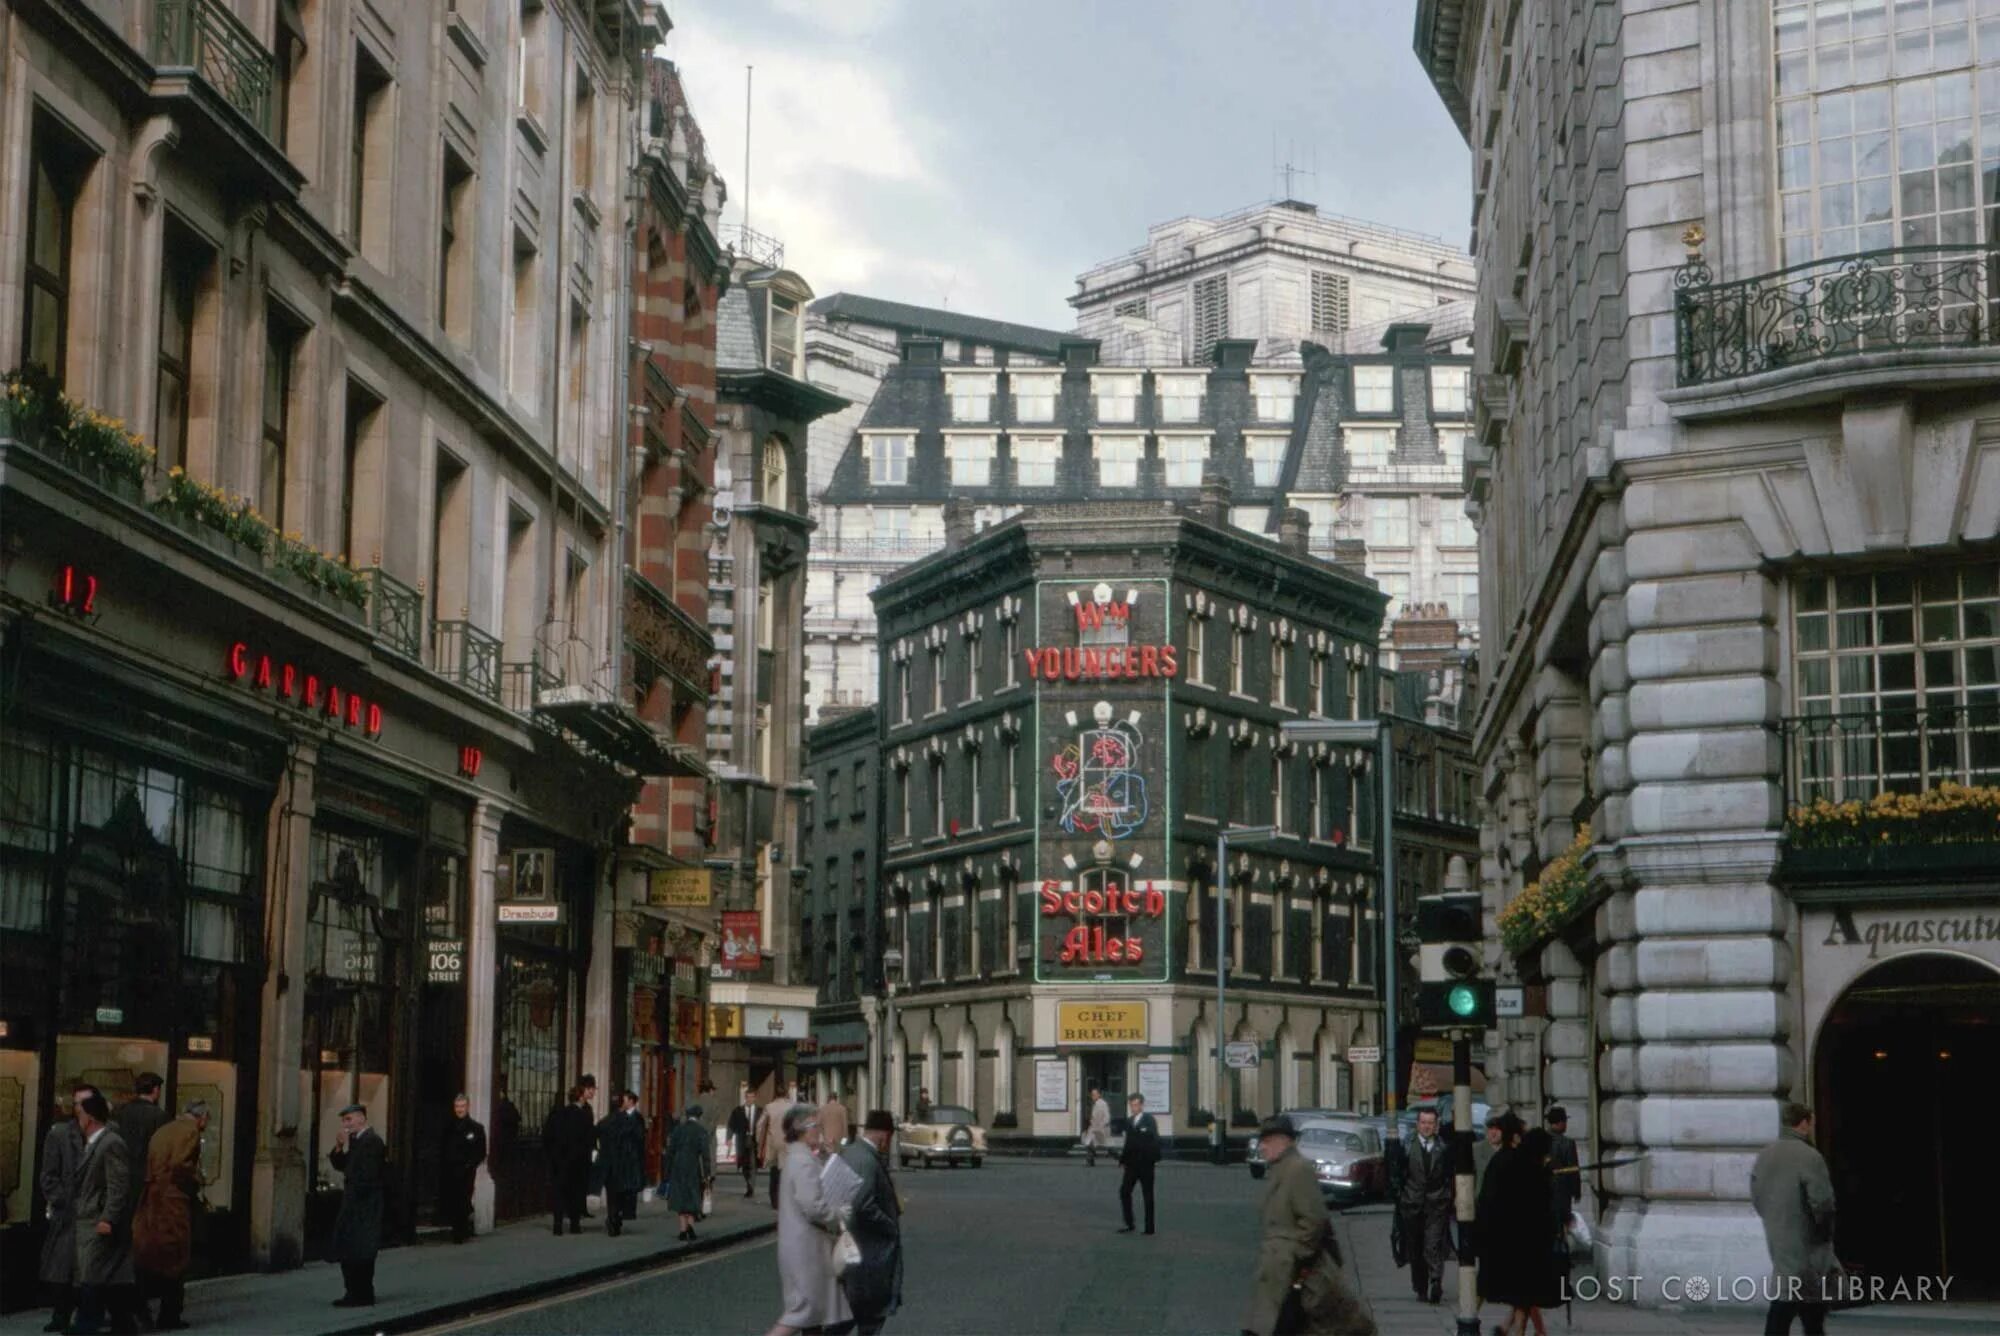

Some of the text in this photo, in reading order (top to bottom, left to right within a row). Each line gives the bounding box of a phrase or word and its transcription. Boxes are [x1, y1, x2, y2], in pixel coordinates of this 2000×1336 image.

[1024, 645, 1177, 680] YOUNGERS
[231, 641, 383, 734] GARRARD
[1040, 880, 1164, 917] Scotch
[502, 907, 555, 919] Drambuie
[429, 942, 462, 952] REGENT
[1060, 925, 1144, 963] Ales
[430, 954, 461, 970] 106
[428, 972, 461, 982] STREET
[1077, 1011, 1128, 1022] CHEF
[1064, 1028, 1143, 1040] BREWER
